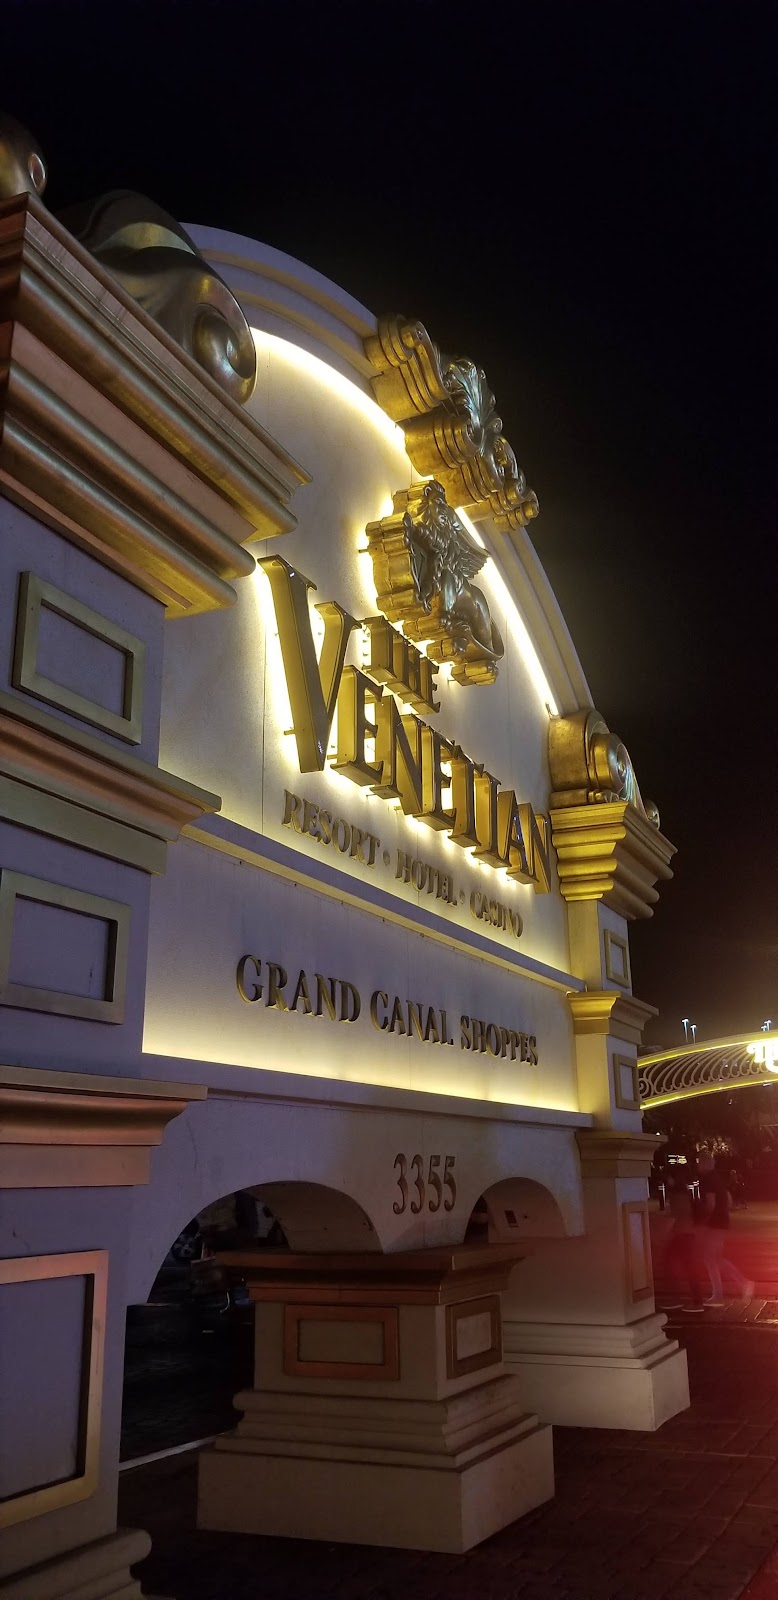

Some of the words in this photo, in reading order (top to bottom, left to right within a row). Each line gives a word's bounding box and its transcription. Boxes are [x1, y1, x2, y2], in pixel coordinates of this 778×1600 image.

[363, 616, 440, 714] THE
[257, 554, 552, 894] VENETIAN
[282, 789, 380, 869] RESORT
[395, 847, 458, 906] HOTEL
[469, 892, 524, 938] CASINO
[236, 954, 361, 1023] GRAND
[370, 990, 454, 1046] CANAL
[460, 1015, 539, 1066] SHOPPES
[392, 1153, 456, 1214] 3355
